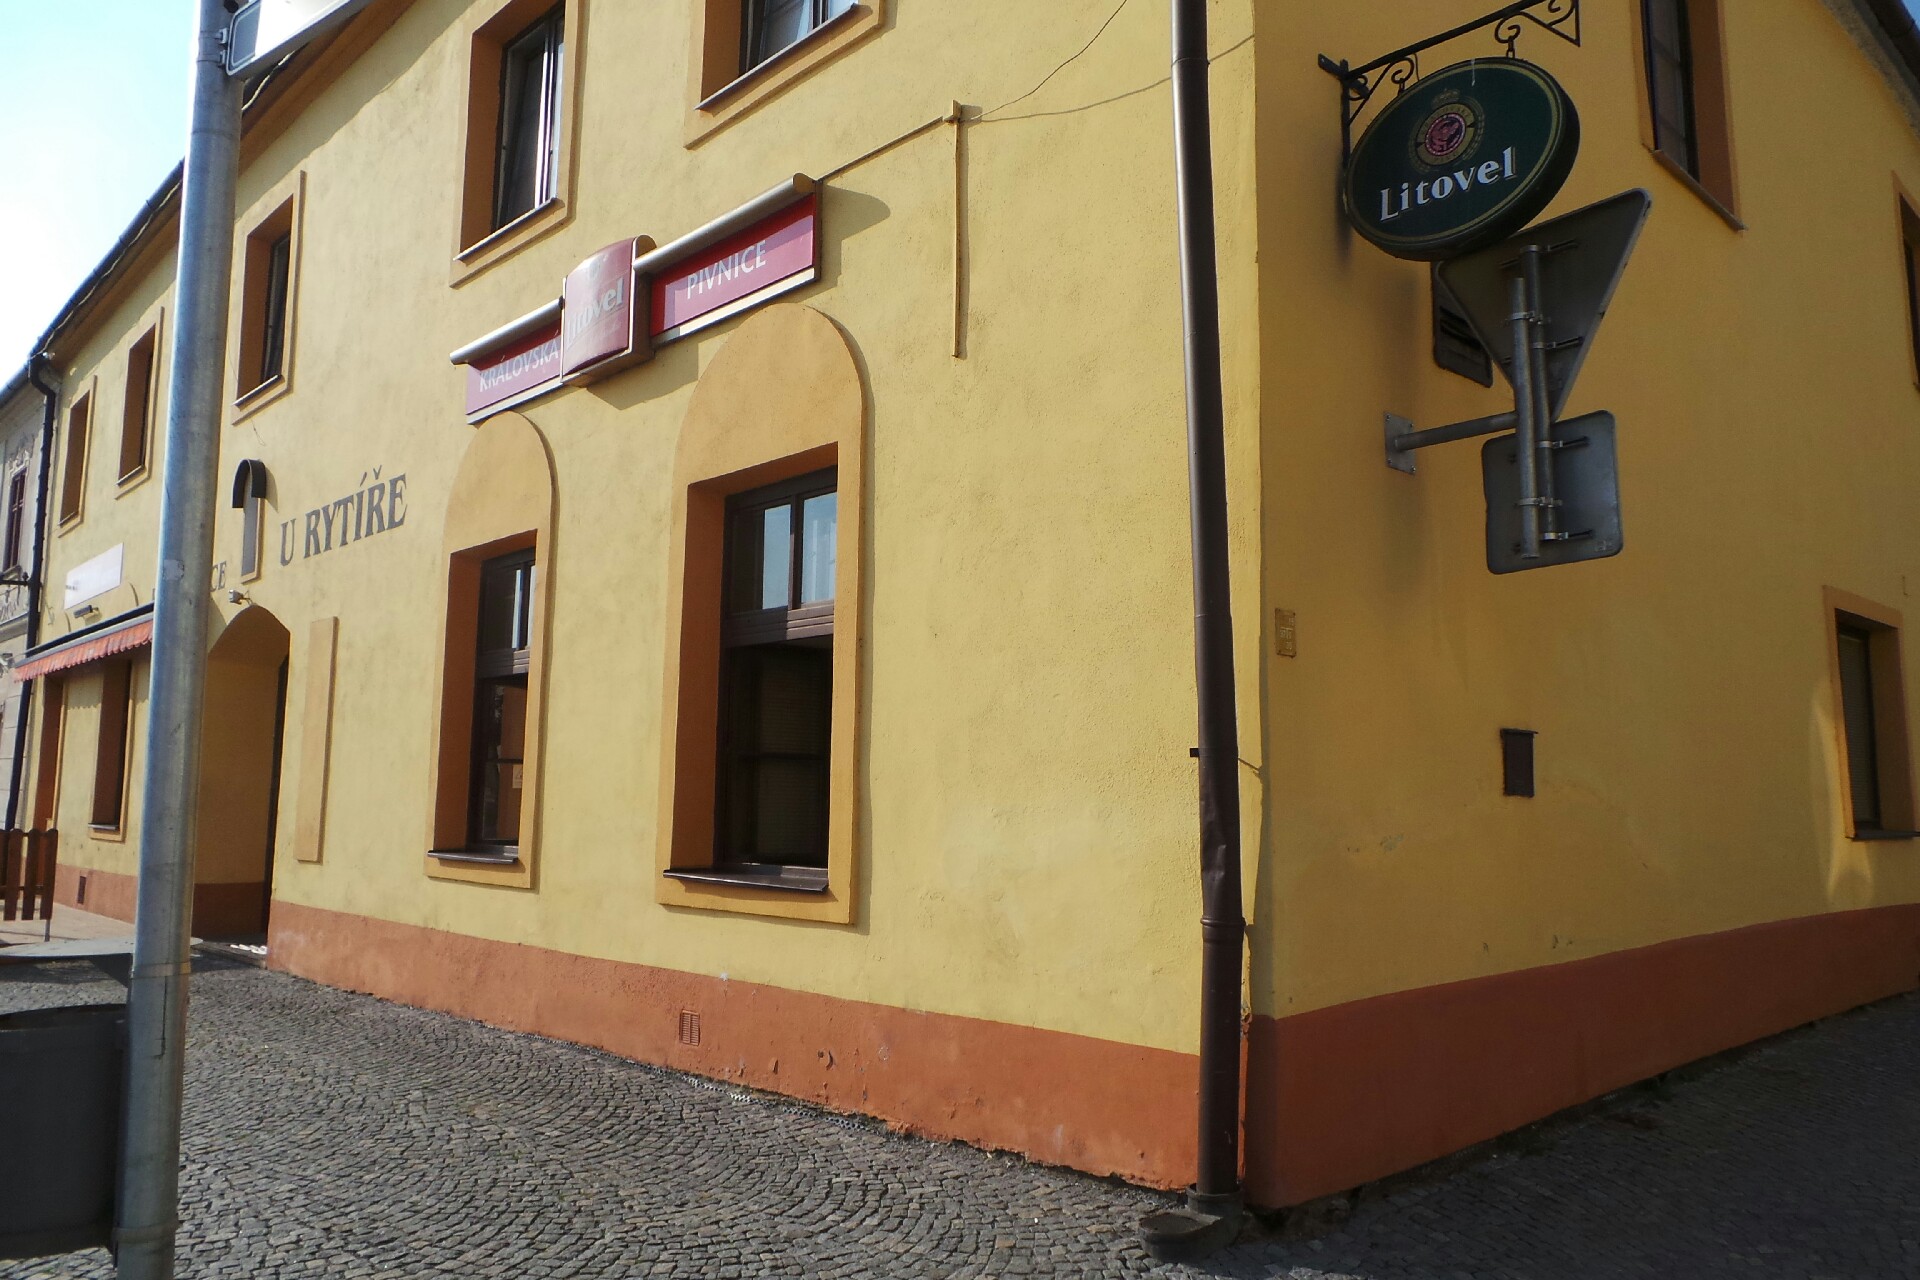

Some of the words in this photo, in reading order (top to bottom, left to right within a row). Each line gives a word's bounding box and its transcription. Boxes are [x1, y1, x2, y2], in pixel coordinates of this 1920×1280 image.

[1380, 146, 1516, 221] Litovel
[687, 240, 766, 299] PIVNICE
[480, 329, 559, 392] KRÁLOVSKÁ
[280, 518, 297, 567] U
[303, 464, 408, 559] RYTÍŘE
